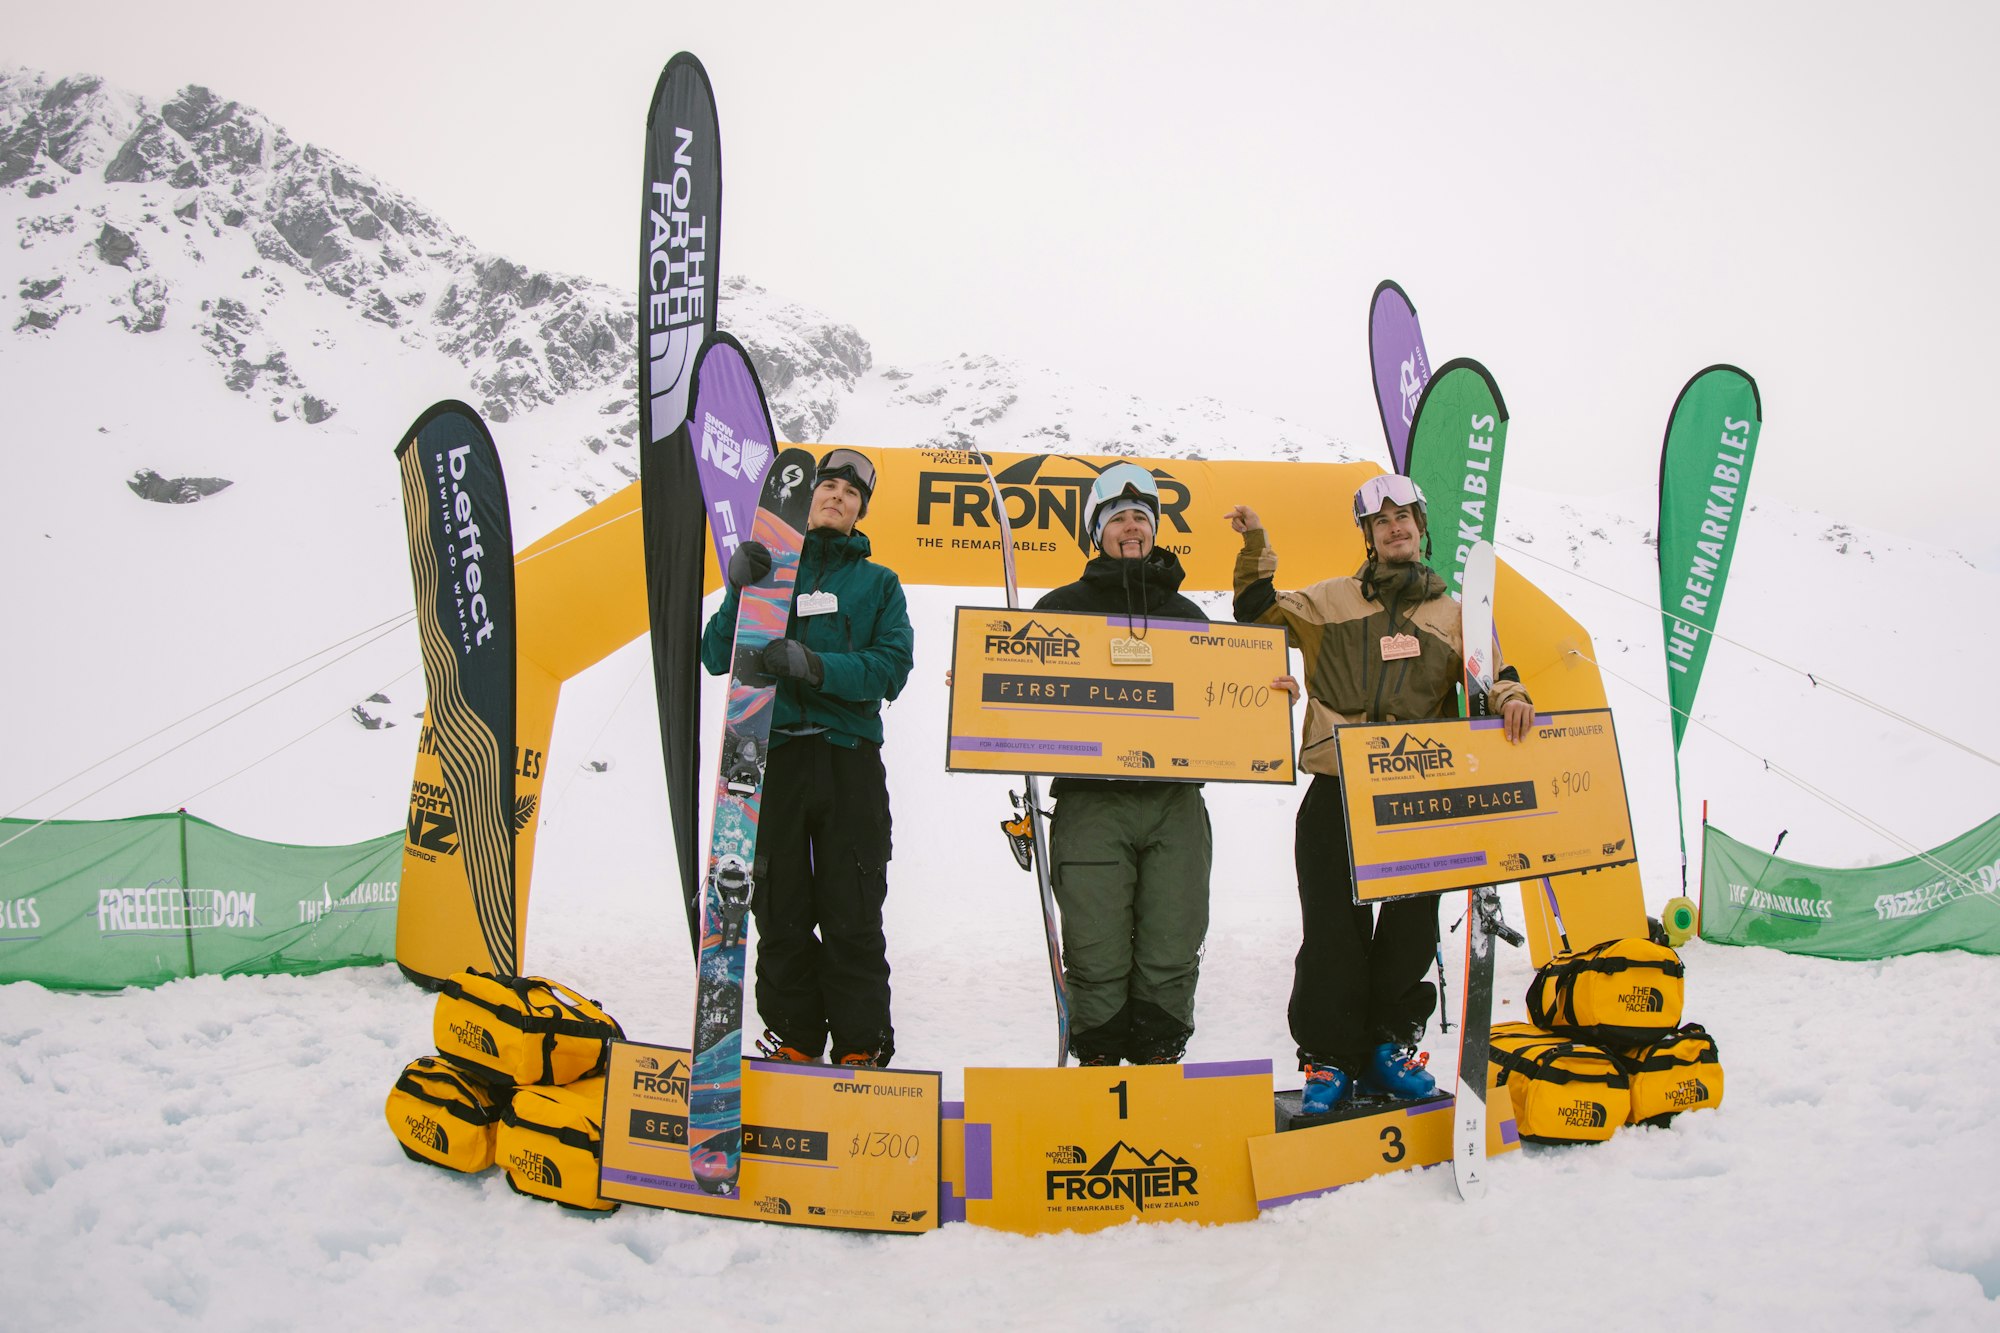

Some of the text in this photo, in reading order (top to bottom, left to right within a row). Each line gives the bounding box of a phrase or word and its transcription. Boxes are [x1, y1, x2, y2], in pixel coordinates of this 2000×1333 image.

[669, 127, 693, 325] NORTH
[650, 182, 672, 329] FACE
[688, 216, 706, 320] THE
[705, 412, 733, 437] SNOW
[704, 421, 740, 452] SPORTS
[701, 431, 740, 476] NZ
[917, 472, 1192, 559] FRONTR
[436, 453, 471, 654] BREWING CO. WANAKA
[448, 445, 494, 646] b.effect
[916, 538, 943, 548] THE
[952, 539, 1056, 552] REMARABLES
[1668, 416, 1750, 674] THE REMARKABLES
[985, 635, 1080, 665] FRONTIER
[1200, 636, 1273, 650] FWT QUALIFIER
[1000, 682, 1157, 703] FIRST PLACE
[1205, 681, 1269, 708] $1900
[1548, 725, 1604, 738] FWT QUALIFIER
[1368, 749, 1454, 780] FRONTIER
[412, 781, 447, 799] NOW
[410, 793, 452, 814] PORT
[1390, 790, 1524, 816] THIRD PLACE
[406, 806, 458, 854] NZ
[1602, 847, 1615, 855] NZ
[1395, 863, 1430, 872] ABSOLUTELY
[1450, 856, 1483, 865] FREERIDING
[1499, 859, 1520, 867] NORTH
[1728, 883, 1748, 905] THE
[1750, 888, 1832, 919] REMARKABLES
[298, 900, 324, 922] THE
[1618, 994, 1649, 1004] NORTH
[1632, 986, 1650, 995] THE
[1626, 1003, 1648, 1012] FACE
[449, 1023, 481, 1043] NORTH
[465, 1020, 482, 1036] THE
[458, 1037, 482, 1051] FACE
[633, 1071, 690, 1106] FRONT
[845, 1083, 923, 1098] FWT QUALIFIER
[1665, 1087, 1696, 1100] NORTH
[1677, 1079, 1695, 1089] THE
[1109, 1080, 1128, 1120] 1
[1574, 1100, 1592, 1110] THE
[1673, 1096, 1695, 1107] FACE
[421, 1114, 436, 1129] THE
[1558, 1107, 1592, 1118] NORTH
[1565, 1117, 1590, 1127] FACE
[405, 1115, 436, 1138] NORTH
[645, 1119, 811, 1152] SEC PLACE
[410, 1130, 434, 1147] FACE
[849, 1132, 919, 1158] $1300
[1380, 1126, 1406, 1163] 3
[510, 1154, 542, 1173] NORTH
[523, 1149, 543, 1164] THE
[640, 1176, 677, 1187] ABSOLUTELY
[680, 1183, 695, 1191] EPIC
[1046, 1166, 1199, 1212] FRONTIER
[754, 1200, 778, 1208] NORTH
[760, 1207, 778, 1215] FACE
[1066, 1204, 1125, 1212] REMARKABLES
[1164, 1200, 1200, 1208] ZEALAND
